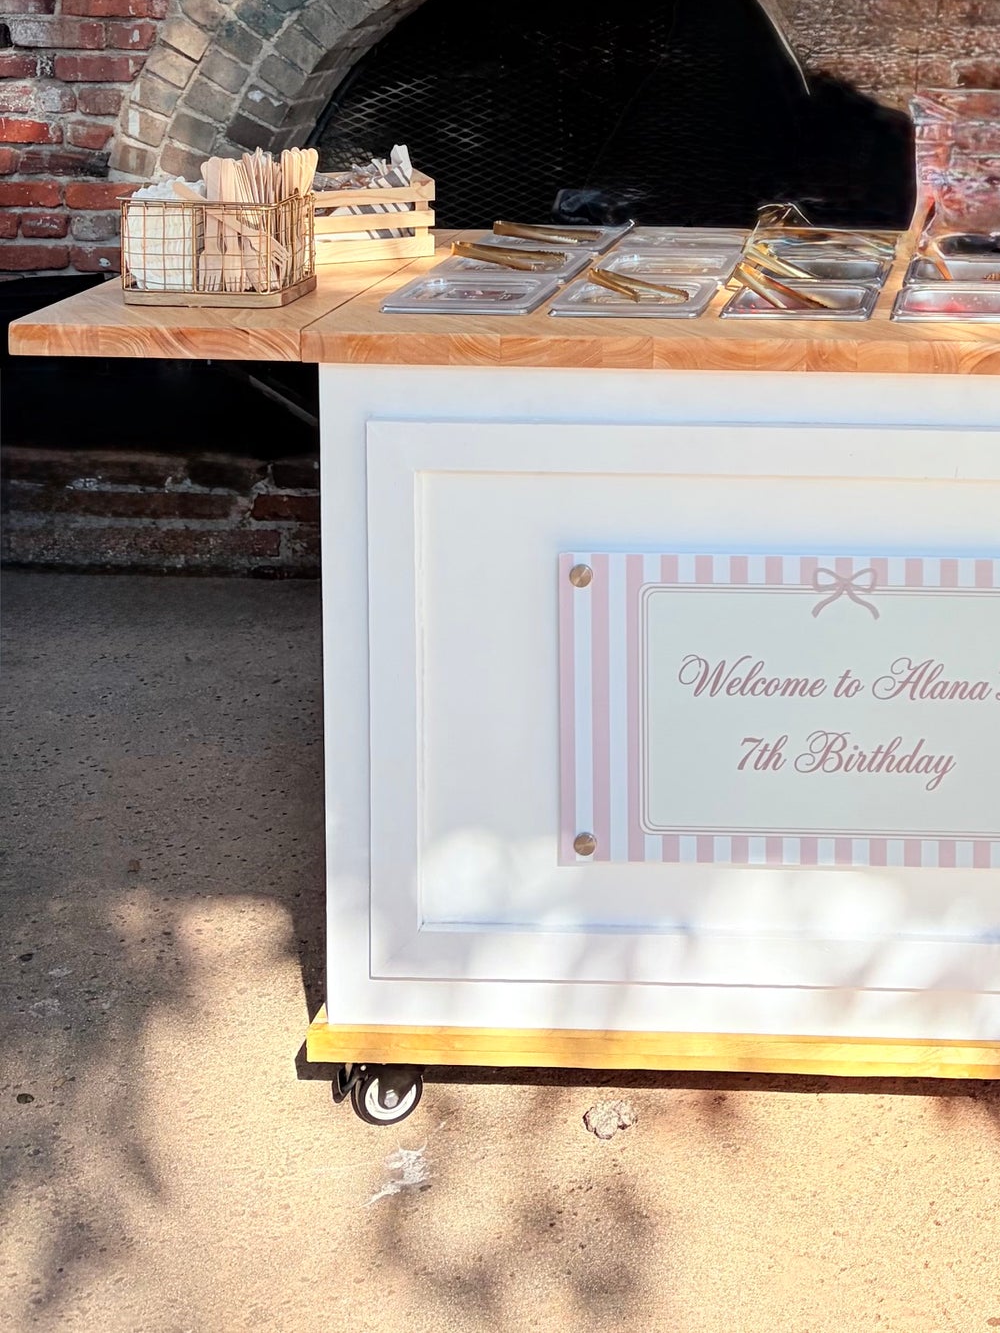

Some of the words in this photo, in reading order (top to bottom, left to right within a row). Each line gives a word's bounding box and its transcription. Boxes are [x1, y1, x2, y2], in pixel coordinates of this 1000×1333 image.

[677, 653, 828, 699] Welcome
[833, 669, 865, 699] to
[736, 735, 788, 772] 7th
[793, 729, 958, 792] Birthday
